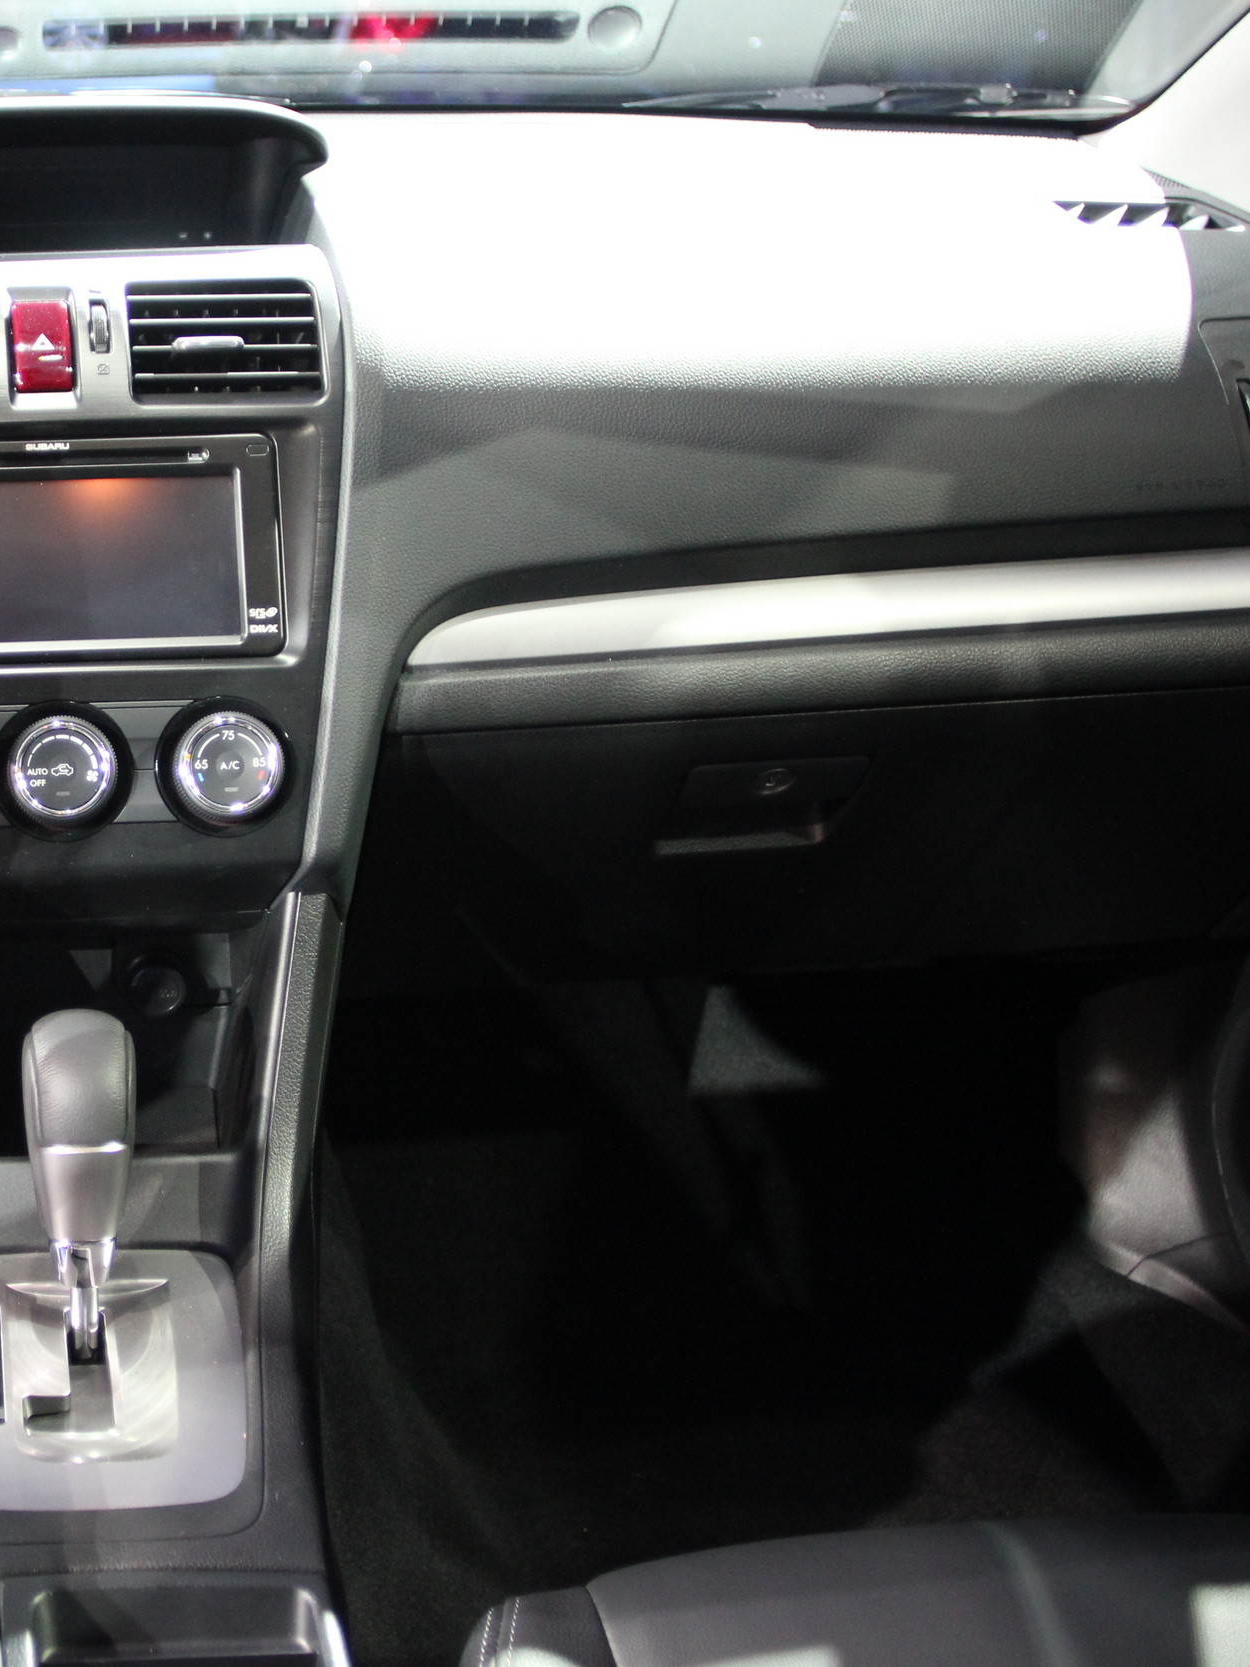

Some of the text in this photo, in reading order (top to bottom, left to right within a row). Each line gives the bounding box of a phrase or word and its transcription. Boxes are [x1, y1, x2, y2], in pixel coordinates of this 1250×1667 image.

[25, 442, 70, 451] SUBARU
[221, 730, 236, 740] 75
[194, 759, 209, 770] 65
[220, 760, 240, 770] A/C
[252, 757, 267, 767] 85
[27, 768, 49, 776] AUTO
[29, 779, 47, 787] OFF
